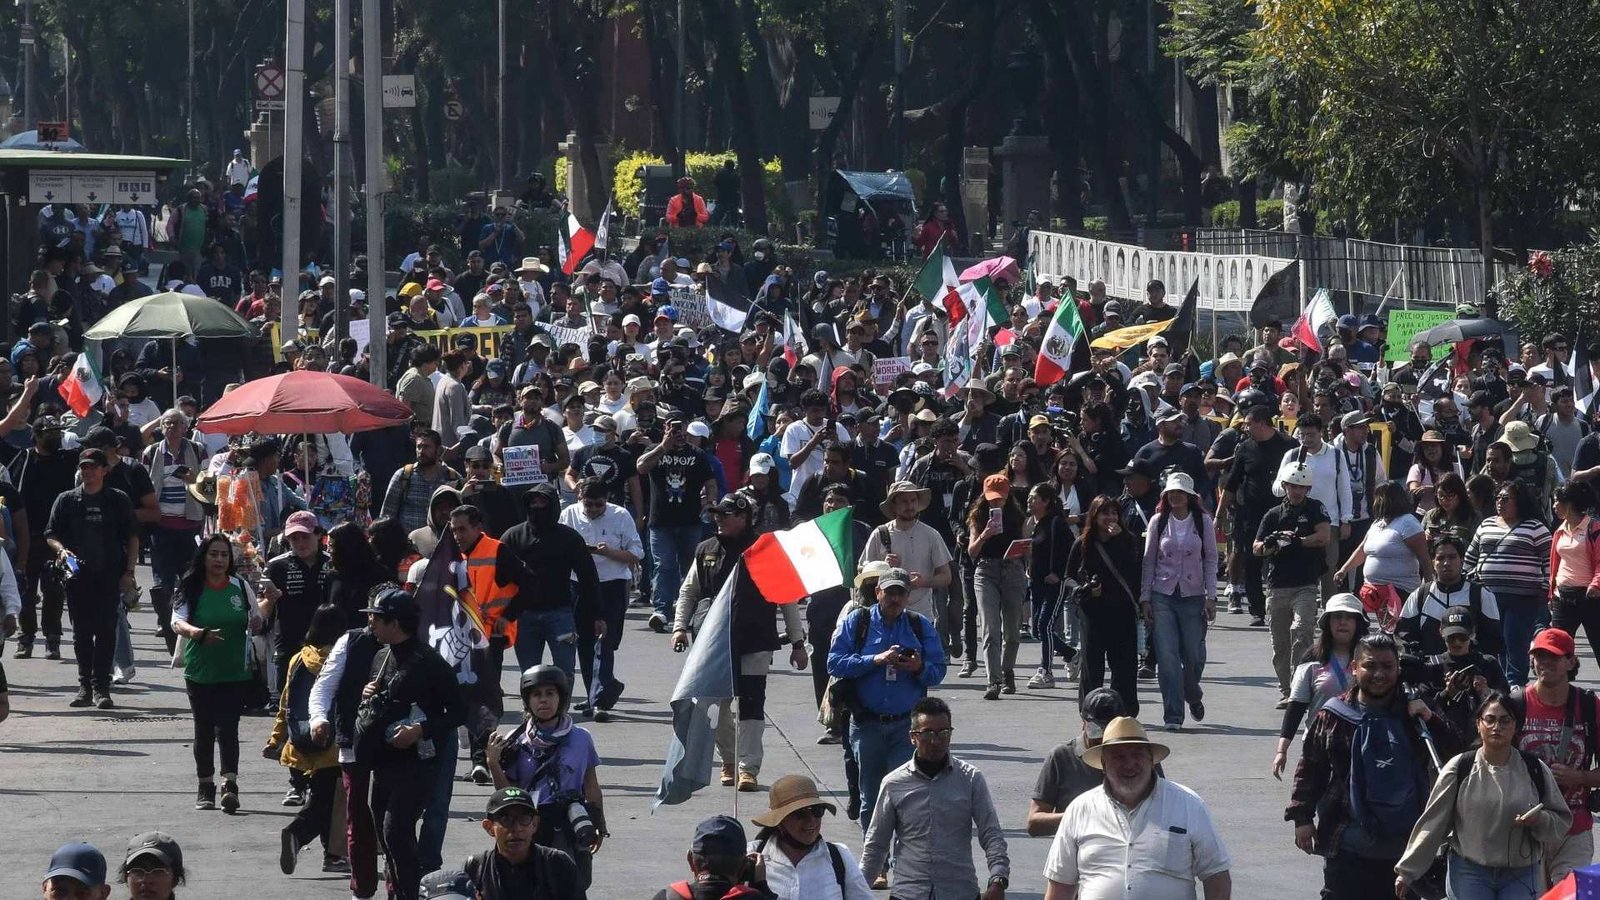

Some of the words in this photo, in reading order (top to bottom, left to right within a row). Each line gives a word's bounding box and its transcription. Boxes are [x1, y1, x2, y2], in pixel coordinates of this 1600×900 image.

[210, 276, 231, 288] GAP
[876, 365, 906, 375] MORENA
[506, 459, 538, 468] morena
[1448, 614, 1464, 623] CAT
